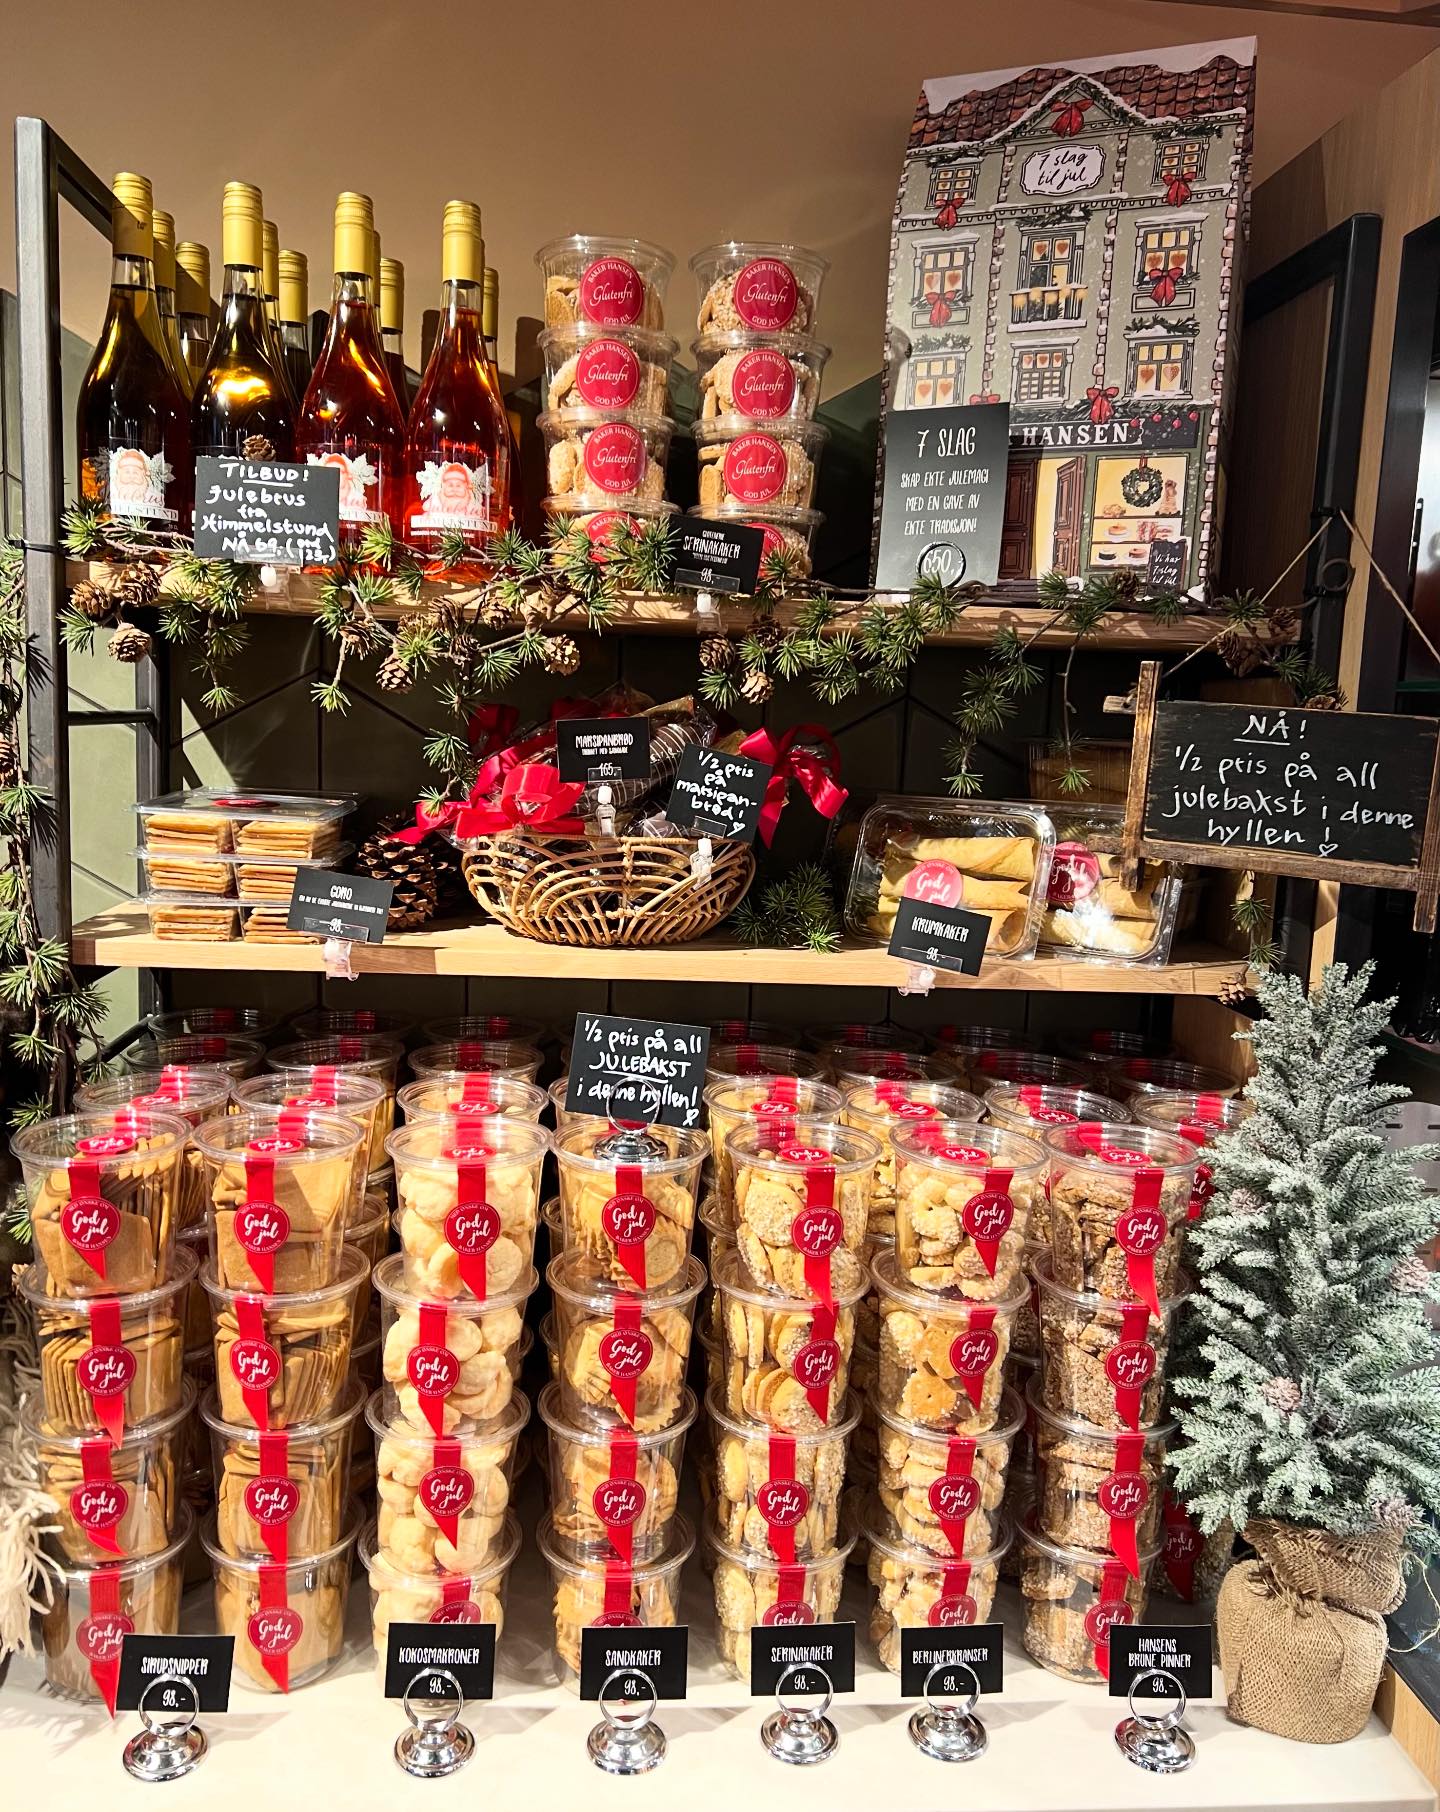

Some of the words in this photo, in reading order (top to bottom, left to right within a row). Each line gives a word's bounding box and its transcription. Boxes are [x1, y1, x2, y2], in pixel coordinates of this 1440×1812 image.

[1039, 153, 1050, 170] 7
[1053, 150, 1088, 167] slag
[1038, 170, 1059, 186] til
[1057, 167, 1087, 190] jul
[587, 264, 607, 284] BAKER
[607, 262, 634, 280] HANSEN
[745, 262, 767, 281] BAKER
[767, 263, 791, 286] HANSEN
[589, 280, 633, 307] Glutenfri
[742, 282, 788, 307] Glutenfri
[603, 316, 619, 326] GOD
[619, 313, 631, 325] JUL
[751, 316, 768, 325] GOD
[768, 316, 780, 325] JUL
[585, 345, 605, 361] BAKER
[605, 344, 631, 363] HANSEN
[741, 356, 760, 372] BAKER
[760, 355, 787, 372] HANSEN
[583, 361, 628, 385] Glutenfri
[740, 371, 785, 397] Glutenfri
[594, 395, 610, 405] GOD
[611, 395, 623, 405] JUL
[751, 407, 767, 416] GOD
[767, 406, 779, 416] JUL
[593, 426, 614, 444] BAKER
[615, 426, 639, 446] HANSEN
[916, 431, 930, 458] 7
[937, 427, 976, 457] SLAG
[1022, 422, 1130, 446] HANSEN
[593, 446, 637, 470] Glutenfri
[731, 440, 750, 457] BAKER
[751, 438, 777, 454] HANSEN
[219, 462, 309, 481] TILBUD!
[732, 457, 776, 480] Glutenfri
[900, 472, 921, 488] SKAP
[924, 470, 945, 487] EKTE
[948, 468, 990, 486] JULEMAGI
[604, 479, 620, 489] GOD
[620, 478, 633, 488] JUL
[743, 489, 759, 499] GOD
[759, 487, 772, 498] JUL
[205, 485, 306, 506] Julebrus
[905, 496, 925, 512] MED
[927, 495, 940, 511] EN
[943, 495, 966, 511] GAVE
[968, 493, 980, 510] AV
[237, 503, 267, 519] fra
[200, 513, 335, 543] Himmelstund
[904, 520, 926, 535] EKTE
[929, 518, 978, 534] TRADISJON!
[222, 530, 250, 553] NÅ
[683, 535, 741, 559] SERINAKAKER
[704, 769, 727, 788] på
[724, 763, 754, 779] pris
[1218, 752, 1268, 784] pris
[1284, 752, 1318, 787] på
[1336, 761, 1379, 790] all
[676, 779, 758, 807] marsipan-
[1161, 784, 1308, 818] julebakst
[1321, 796, 1328, 820] i
[1339, 801, 1414, 830] denne
[330, 885, 353, 901] GOMO
[916, 873, 944, 897] God
[911, 916, 970, 943] KRUMKAKER
[608, 1027, 640, 1053] pris
[644, 1028, 668, 1060] på
[673, 1035, 702, 1055] all
[589, 1051, 692, 1078] JULEBAKST
[576, 1077, 584, 1097] i
[72, 1210, 101, 1235] God
[455, 1212, 481, 1235] God
[612, 1205, 637, 1228] God
[624, 1213, 648, 1236] jul
[974, 1202, 999, 1224] God
[985, 1209, 1006, 1234] jul
[88, 1219, 109, 1243] jul
[244, 1213, 270, 1238] God
[254, 1222, 279, 1245] jul
[466, 1220, 491, 1246] jul
[804, 1218, 829, 1240] God
[1127, 1217, 1153, 1240] God
[1136, 1224, 1159, 1248] jul
[812, 1225, 835, 1250] jul
[611, 1339, 637, 1361] God
[962, 1336, 986, 1358] God
[968, 1346, 990, 1369] jul
[88, 1355, 116, 1380] God
[237, 1351, 261, 1375] God
[248, 1359, 271, 1383] jul
[416, 1356, 440, 1378] God
[615, 1349, 643, 1370] jul
[804, 1353, 828, 1375] God
[814, 1359, 834, 1382] jul
[1117, 1352, 1142, 1375] God
[1126, 1358, 1148, 1383] jul
[100, 1364, 126, 1389] jul
[424, 1365, 449, 1389] jul
[80, 1492, 107, 1515] God
[254, 1488, 280, 1511] God
[604, 1490, 629, 1512] God
[767, 1490, 792, 1511] God
[940, 1484, 964, 1506] God
[949, 1490, 971, 1513] jul
[1111, 1482, 1134, 1505] God
[1123, 1488, 1142, 1512] jul
[92, 1499, 118, 1523] jul
[264, 1496, 289, 1517] jul
[613, 1497, 637, 1518] jul
[779, 1497, 800, 1519] jul
[259, 1617, 284, 1642] God
[269, 1625, 293, 1649] jul
[398, 1647, 480, 1665] KOKOSMAKRONER
[771, 1645, 833, 1663] SERINAKAKER
[912, 1648, 989, 1664] BERLINERKRANSER
[1138, 1637, 1177, 1653] HANSENS
[140, 1656, 209, 1676] SIRUPSNIPPER
[605, 1649, 661, 1667] SANDKAKER
[1128, 1652, 1157, 1669] BRUNE
[1161, 1652, 1192, 1668] PINNER
